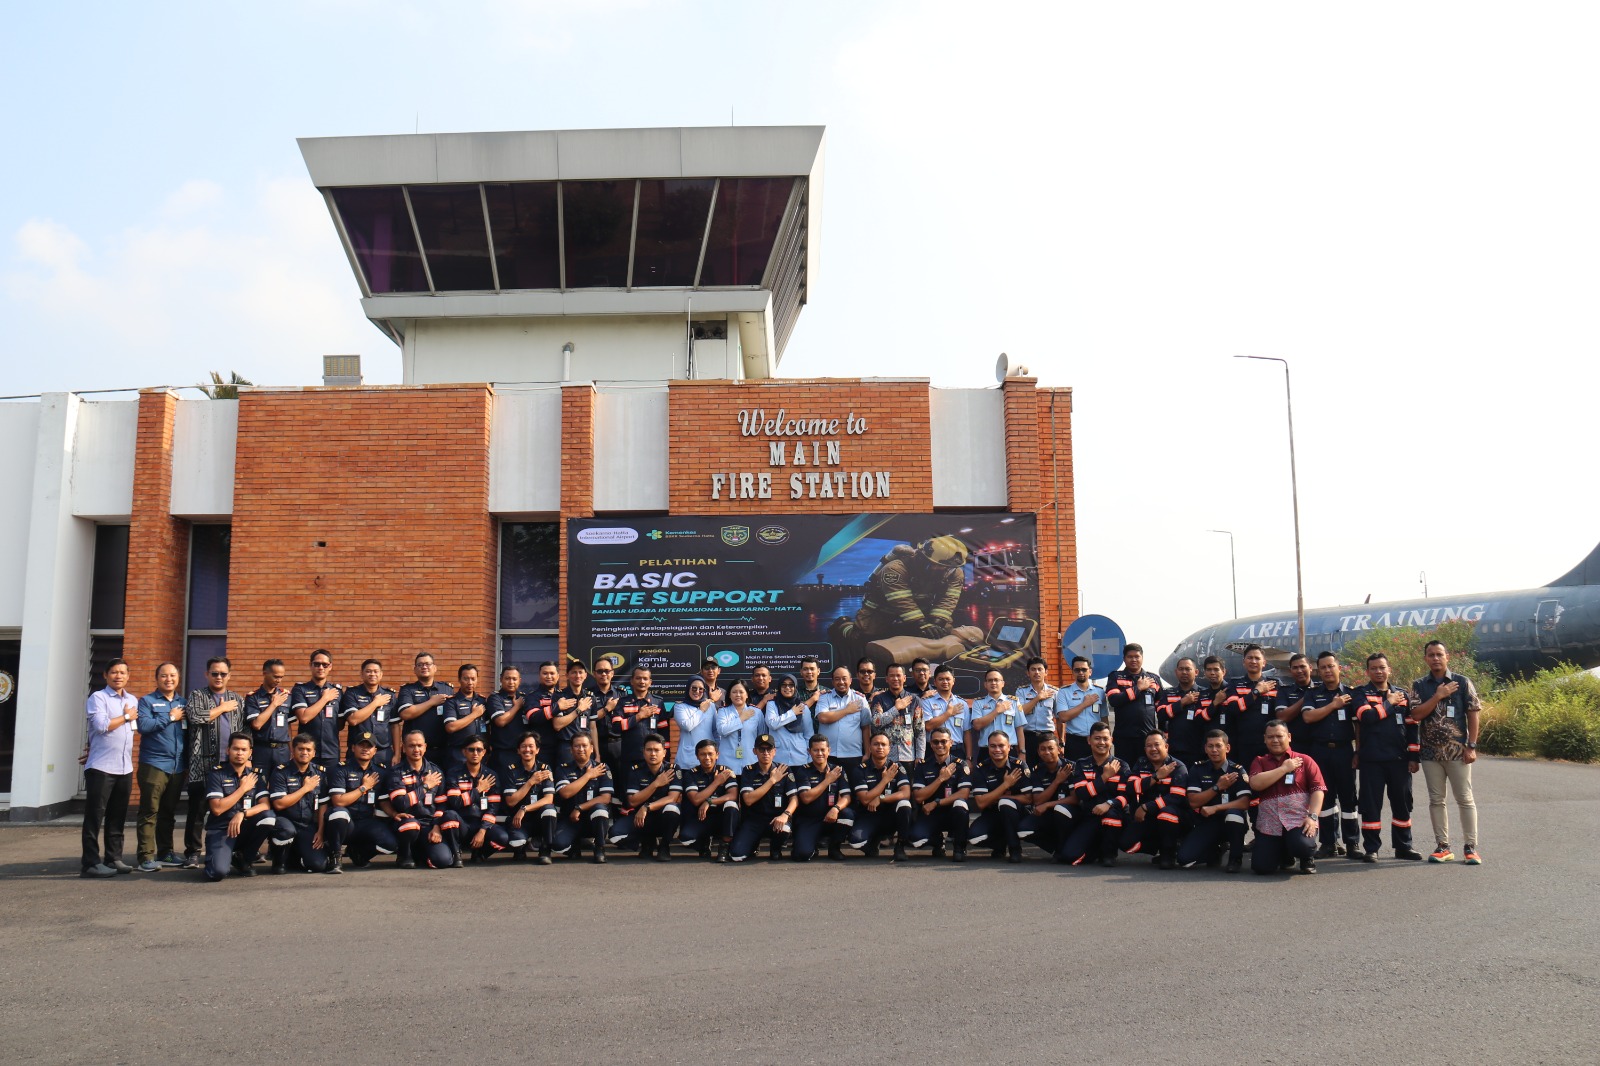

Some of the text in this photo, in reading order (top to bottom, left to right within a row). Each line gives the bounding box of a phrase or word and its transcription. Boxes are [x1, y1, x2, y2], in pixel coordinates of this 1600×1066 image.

[738, 409, 868, 437] Welcome to
[769, 441, 841, 466] MAIN
[711, 472, 890, 499] FIRE STATION
[639, 558, 717, 567] PELATIHAN
[593, 572, 699, 589] BASIC
[591, 590, 784, 606] LIFE SUPPORT
[1238, 604, 1486, 640] ARFF TRAINING
